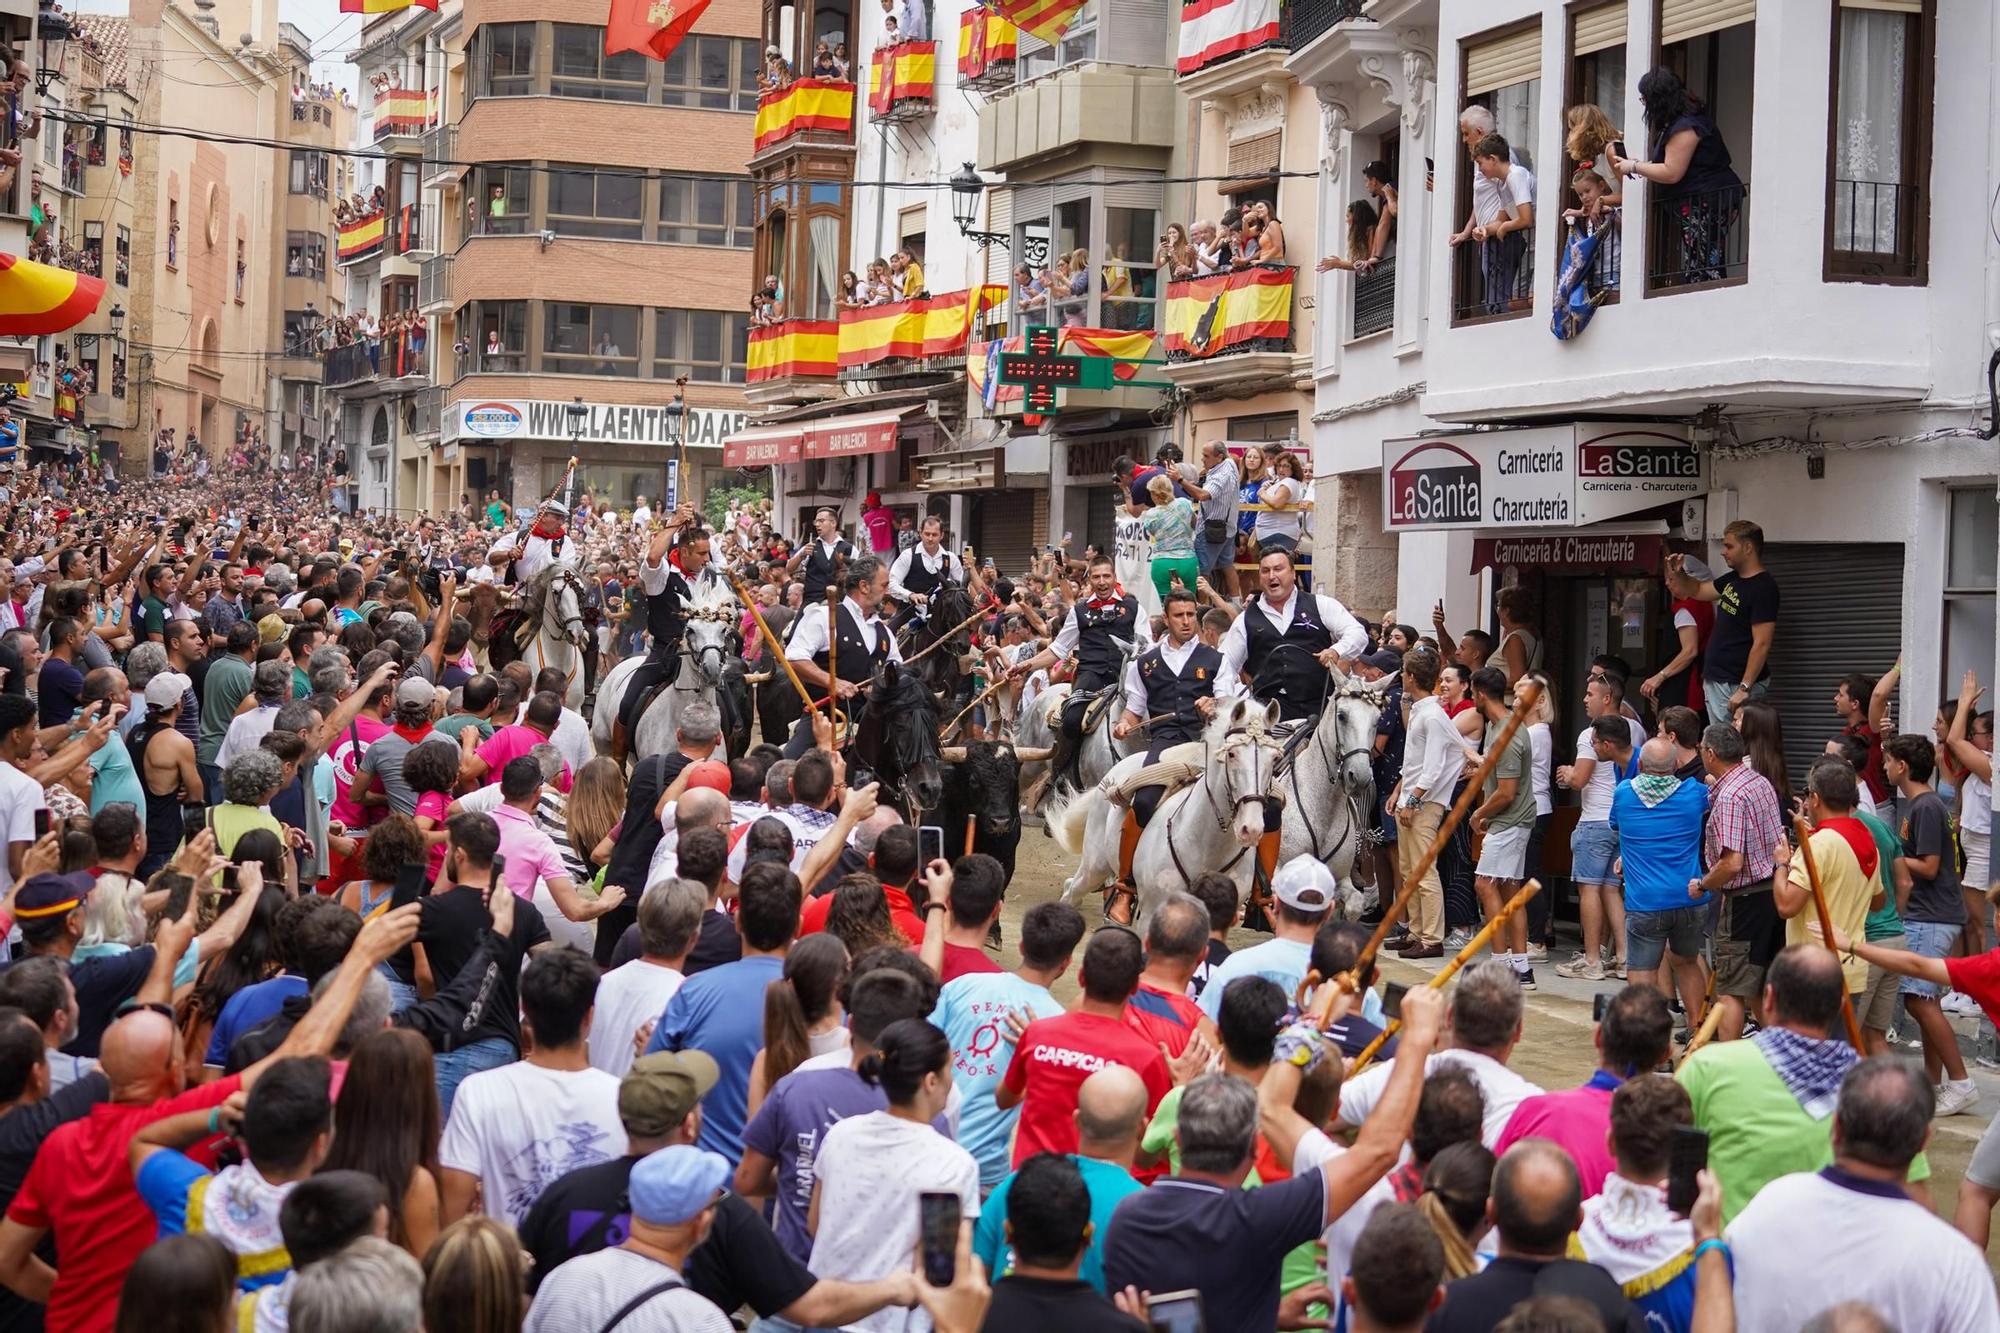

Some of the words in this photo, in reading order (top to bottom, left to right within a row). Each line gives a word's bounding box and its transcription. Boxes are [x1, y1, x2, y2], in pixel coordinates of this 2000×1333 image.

[746, 445, 757, 460] BAR
[756, 443, 779, 459] VALENCIA
[829, 434, 841, 451] BAR
[841, 432, 867, 450] VALENCIA
[1497, 445, 1563, 475] Carnicería
[1493, 492, 1568, 522] Charcutería
[1494, 538, 1550, 564] Carnicería
[1553, 538, 1561, 563] &
[1565, 535, 1635, 563] Charcutería
